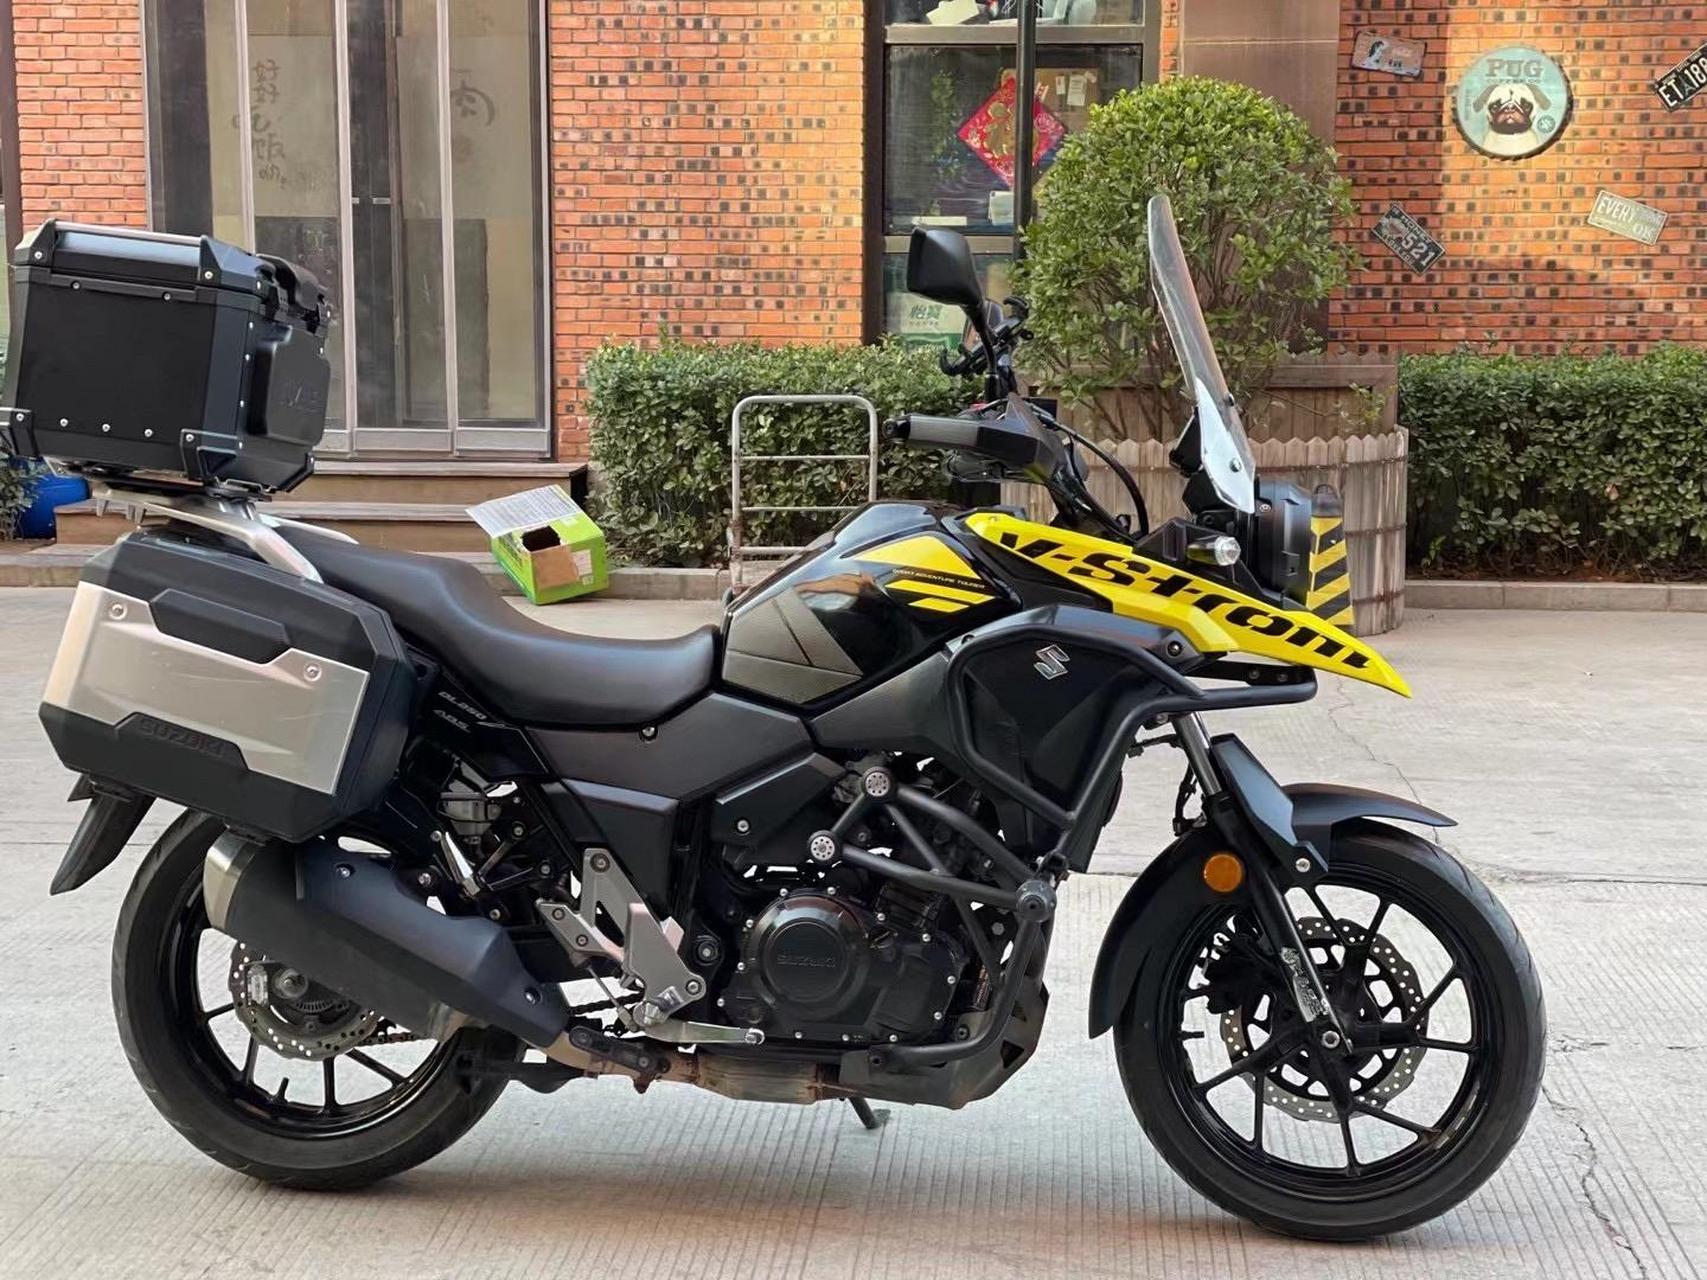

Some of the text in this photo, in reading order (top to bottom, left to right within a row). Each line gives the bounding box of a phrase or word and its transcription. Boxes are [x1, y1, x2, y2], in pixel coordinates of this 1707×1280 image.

[1485, 58, 1543, 77] PUG
[1659, 79, 1684, 106] ET
[1596, 196, 1636, 224] EVERY
[1401, 232, 1435, 266] 521
[140, 720, 224, 758] SUZUKI
